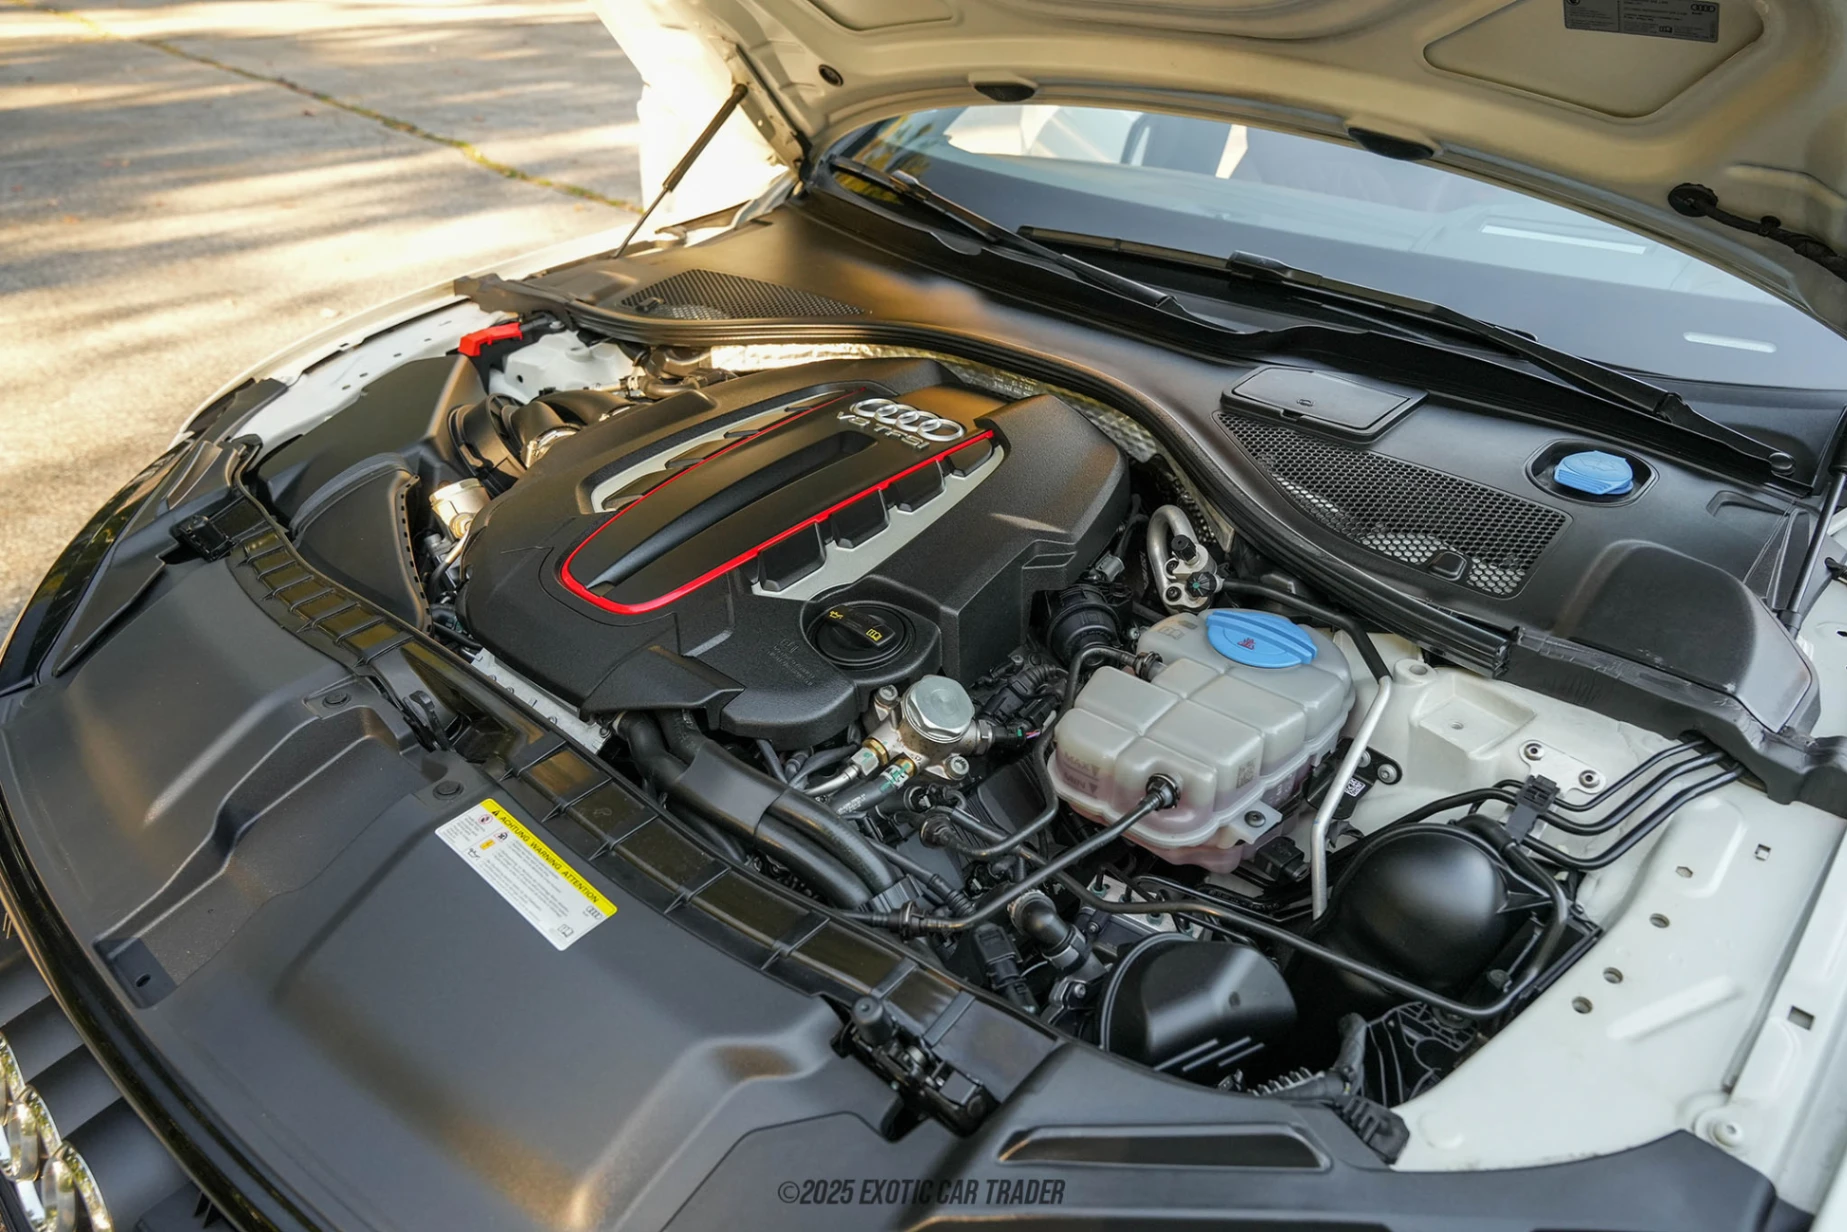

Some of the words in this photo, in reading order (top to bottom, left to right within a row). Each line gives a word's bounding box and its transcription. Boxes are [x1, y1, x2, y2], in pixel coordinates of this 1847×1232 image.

[500, 816, 531, 842] ACHTUNG
[530, 841, 562, 870] WARNING
[562, 870, 599, 903] ATTENTION
